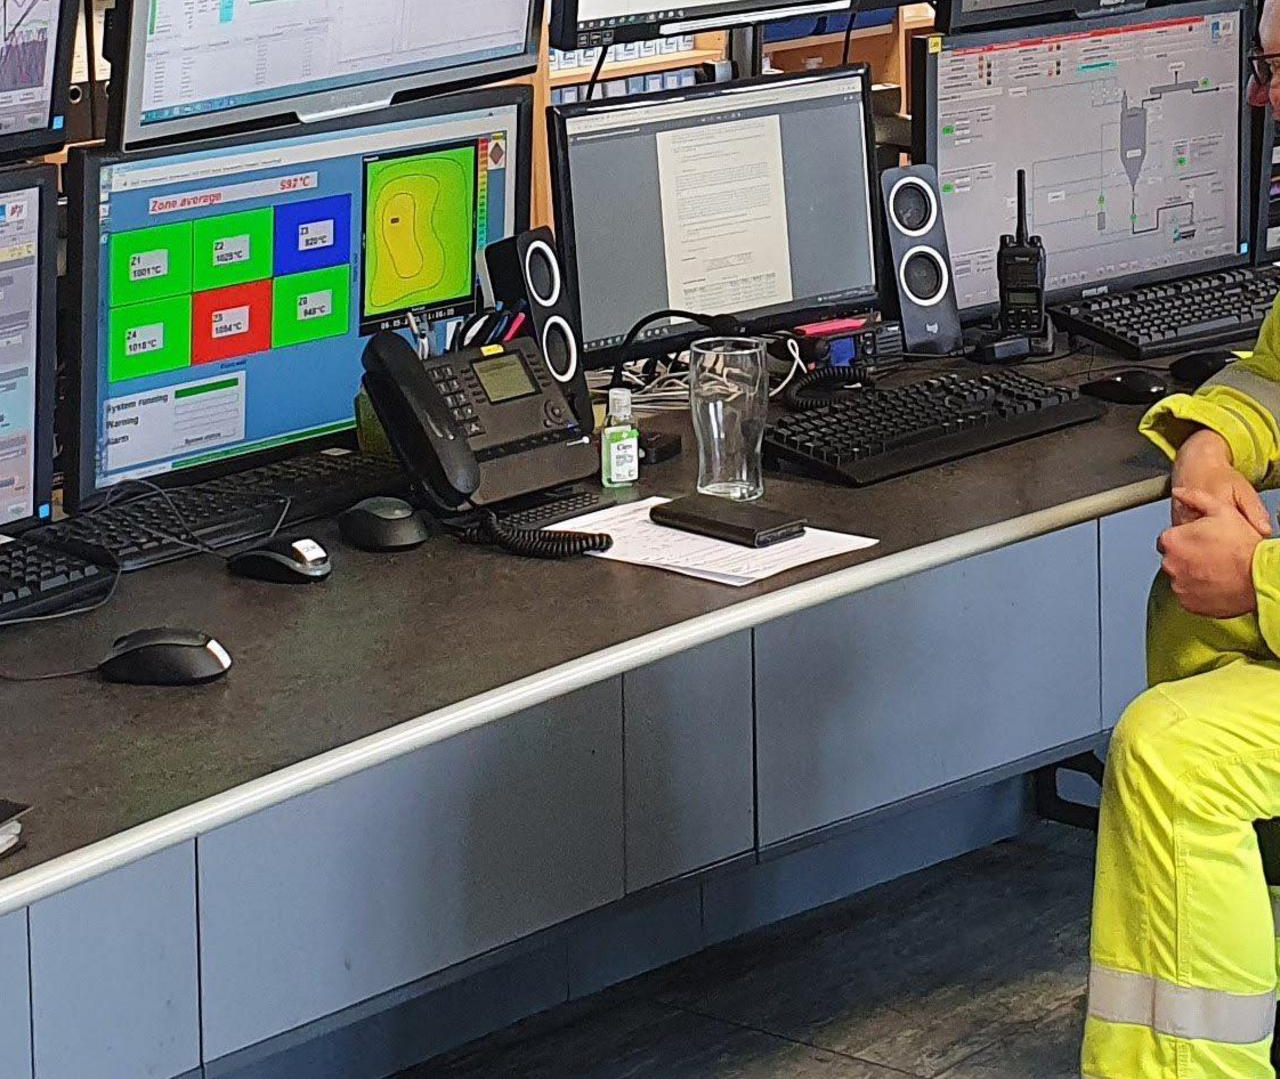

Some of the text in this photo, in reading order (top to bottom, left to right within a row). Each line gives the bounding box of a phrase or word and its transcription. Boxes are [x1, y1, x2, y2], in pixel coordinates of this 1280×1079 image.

[150, 193, 222, 212] Zone average
[214, 241, 224, 250] Z2
[131, 256, 141, 265] Z1
[127, 331, 137, 340] Z4
[138, 394, 168, 407] running
